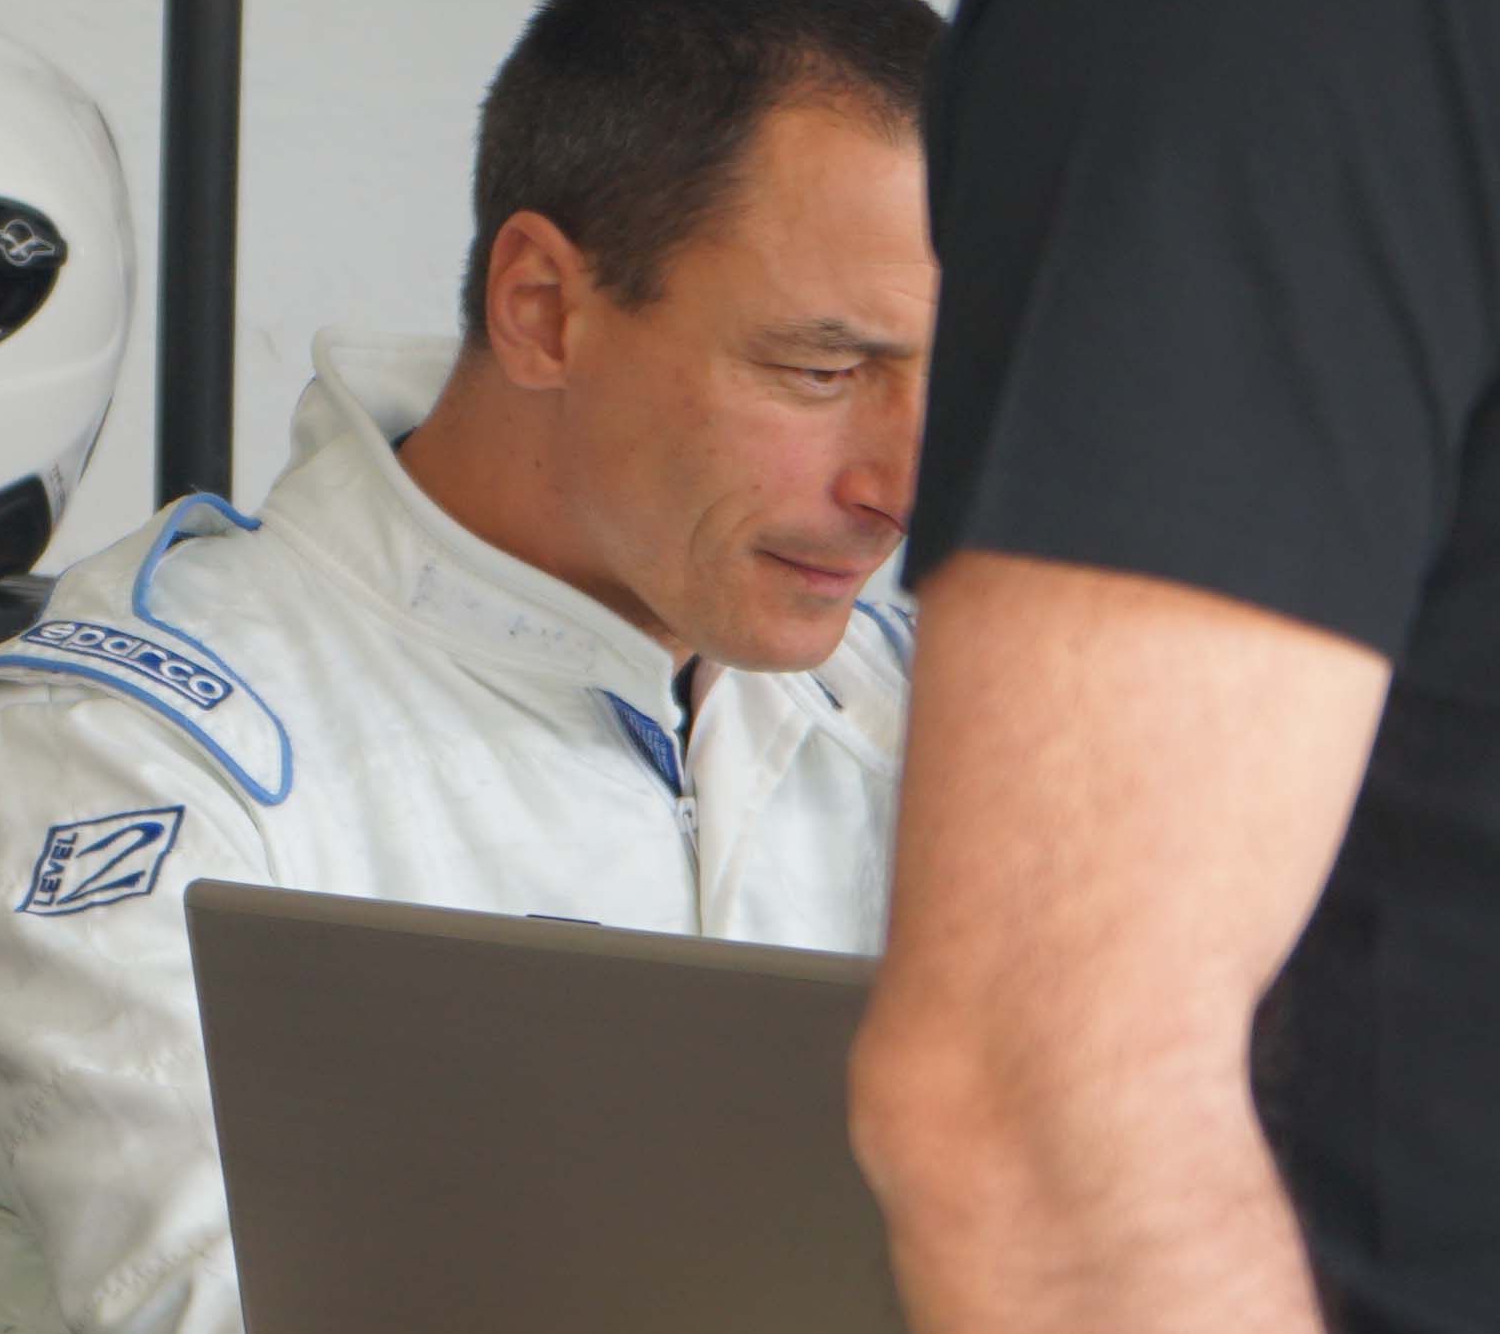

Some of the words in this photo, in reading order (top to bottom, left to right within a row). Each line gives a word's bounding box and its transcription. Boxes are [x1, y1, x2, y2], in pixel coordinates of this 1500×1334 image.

[39, 623, 224, 702] sparco
[33, 831, 79, 907] LEVEL
[57, 821, 166, 906] 2
